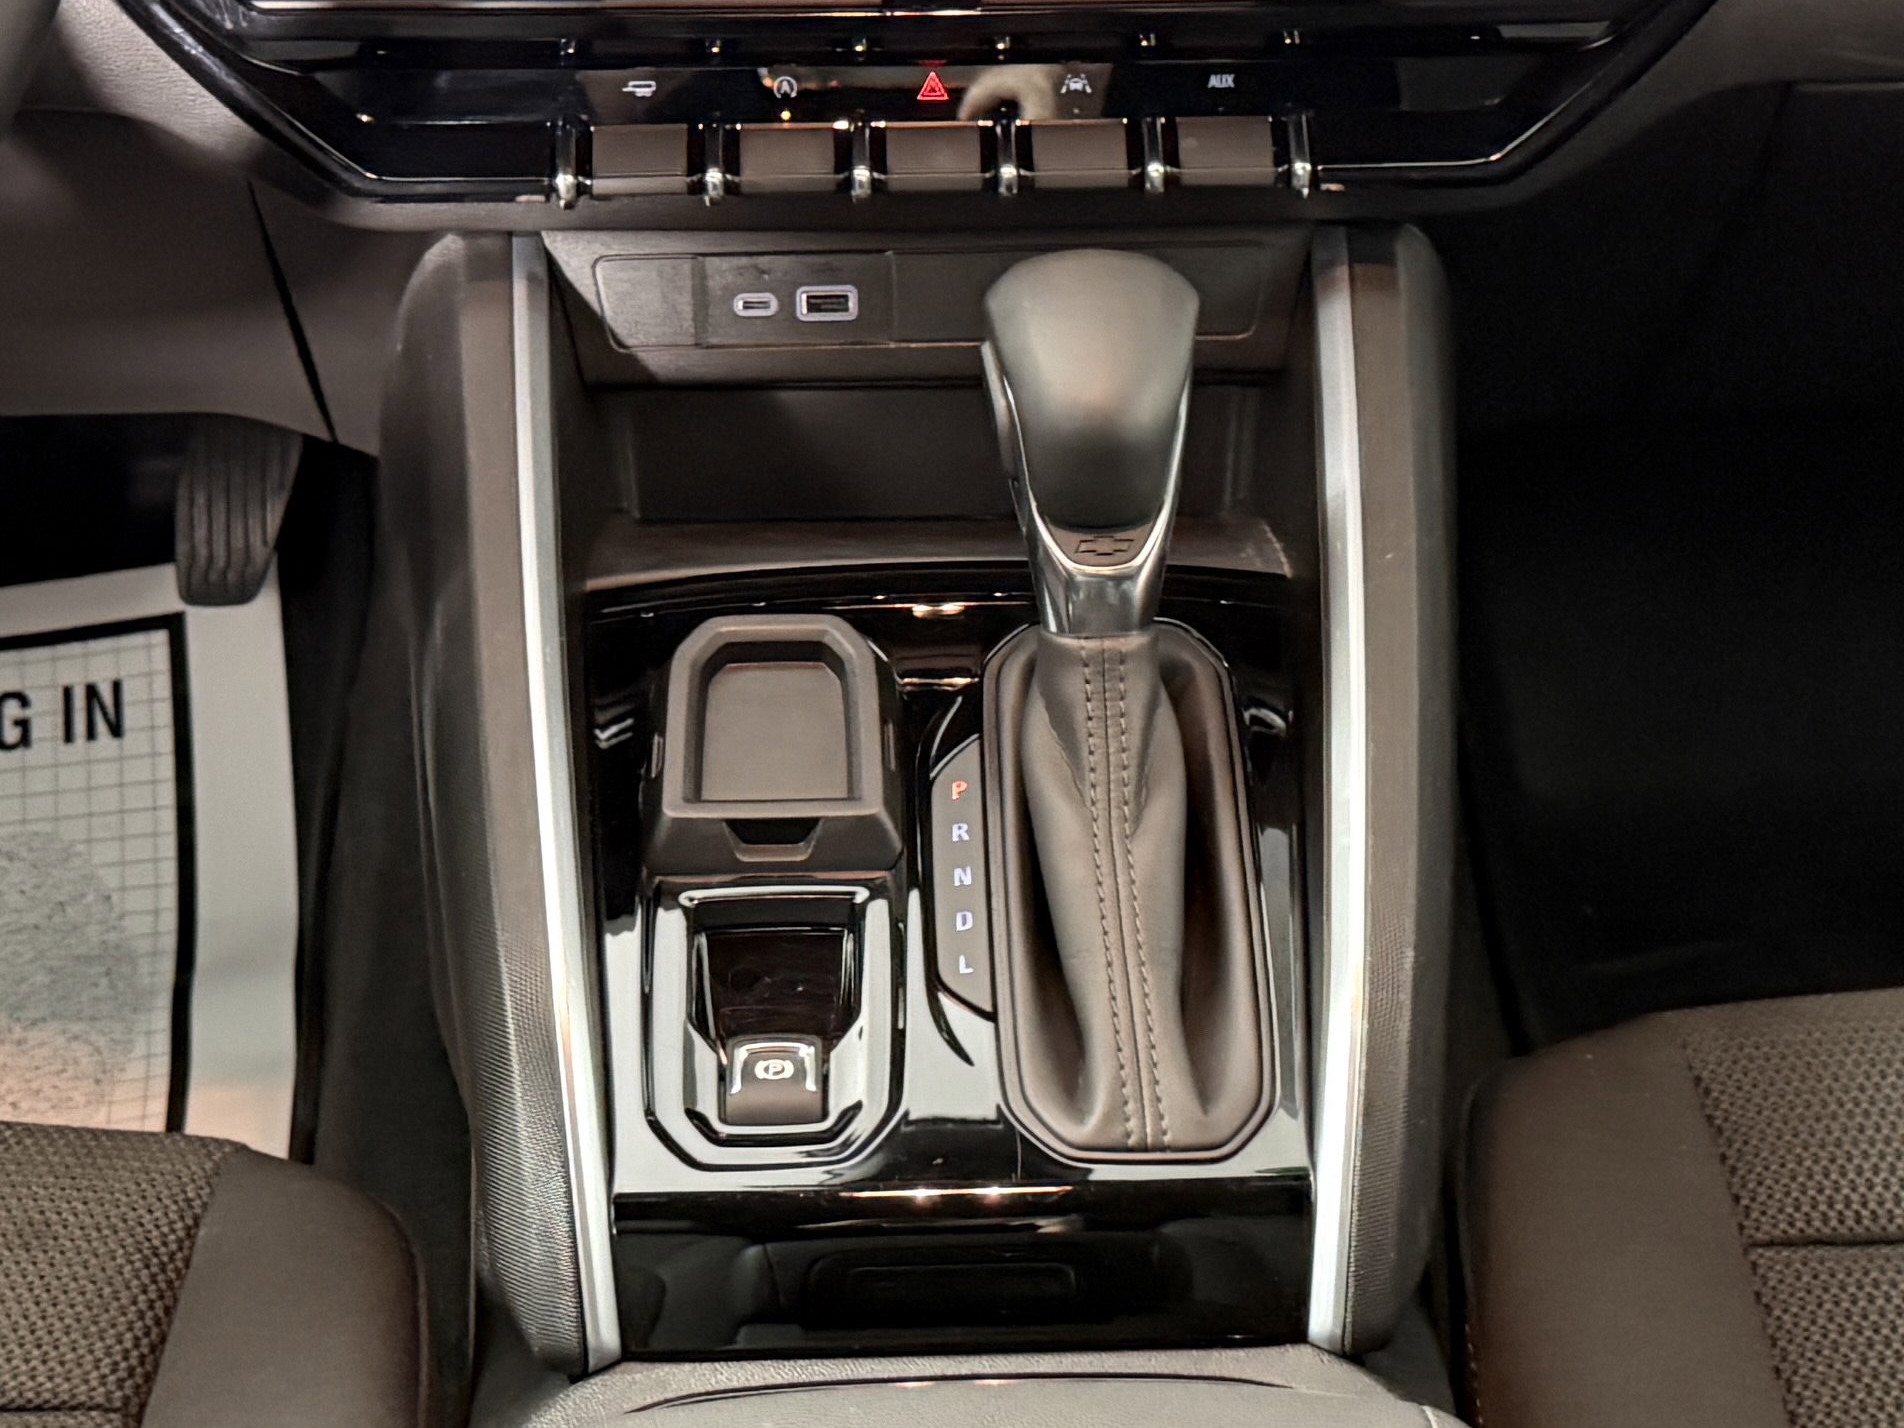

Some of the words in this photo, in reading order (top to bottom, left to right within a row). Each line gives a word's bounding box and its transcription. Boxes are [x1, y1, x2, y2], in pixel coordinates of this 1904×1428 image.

[1207, 73, 1236, 89] AUX
[62, 678, 126, 743] IN
[951, 780, 969, 800] P
[952, 823, 971, 842] R
[953, 866, 973, 886] N
[956, 911, 974, 932] D
[959, 954, 975, 974] L
